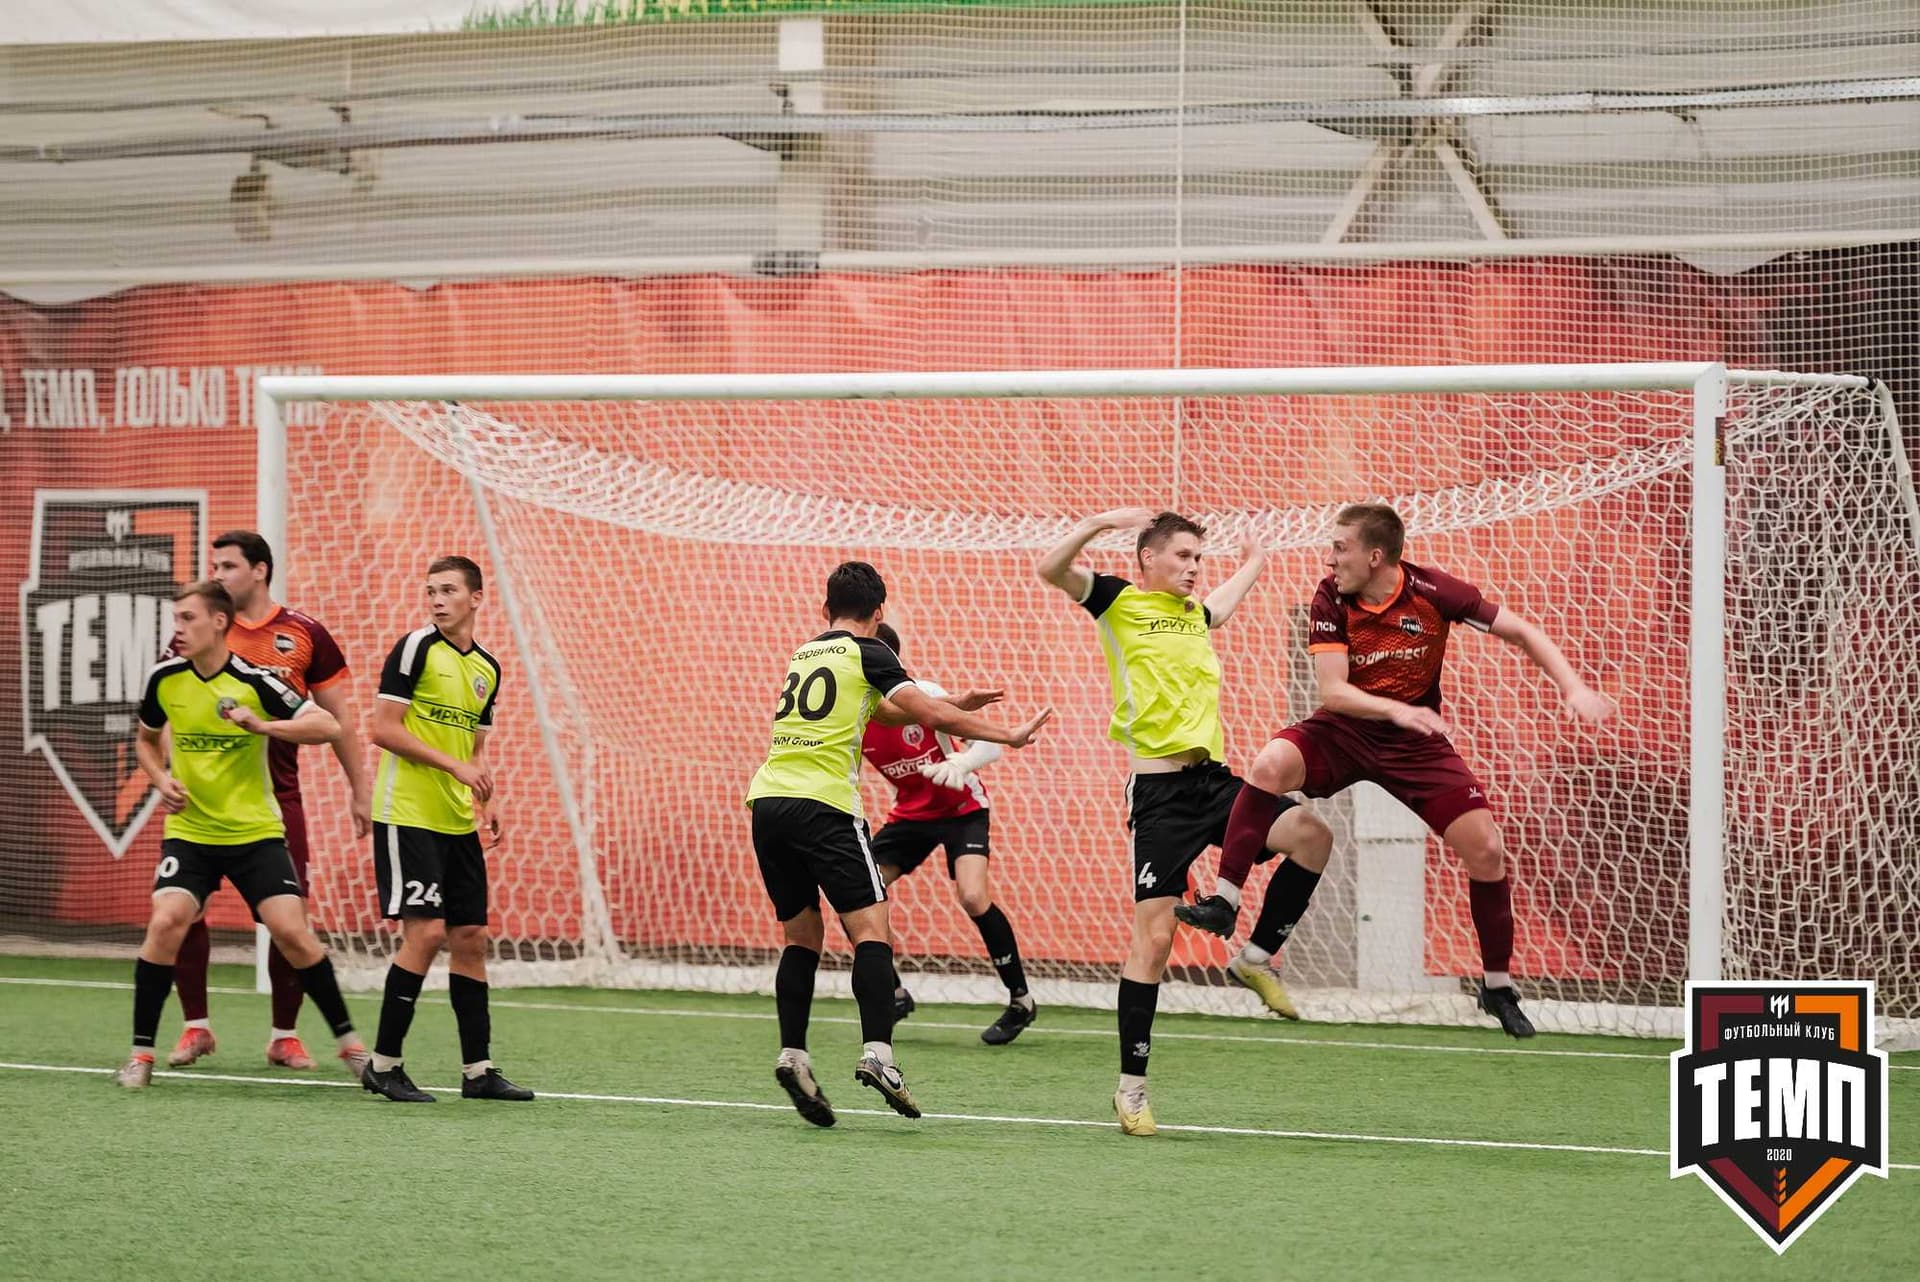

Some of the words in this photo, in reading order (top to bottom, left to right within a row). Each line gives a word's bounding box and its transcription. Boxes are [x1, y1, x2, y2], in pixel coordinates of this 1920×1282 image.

[36, 592, 177, 712] ТЕМ
[1137, 861, 1157, 888] 4
[405, 880, 443, 907] 24
